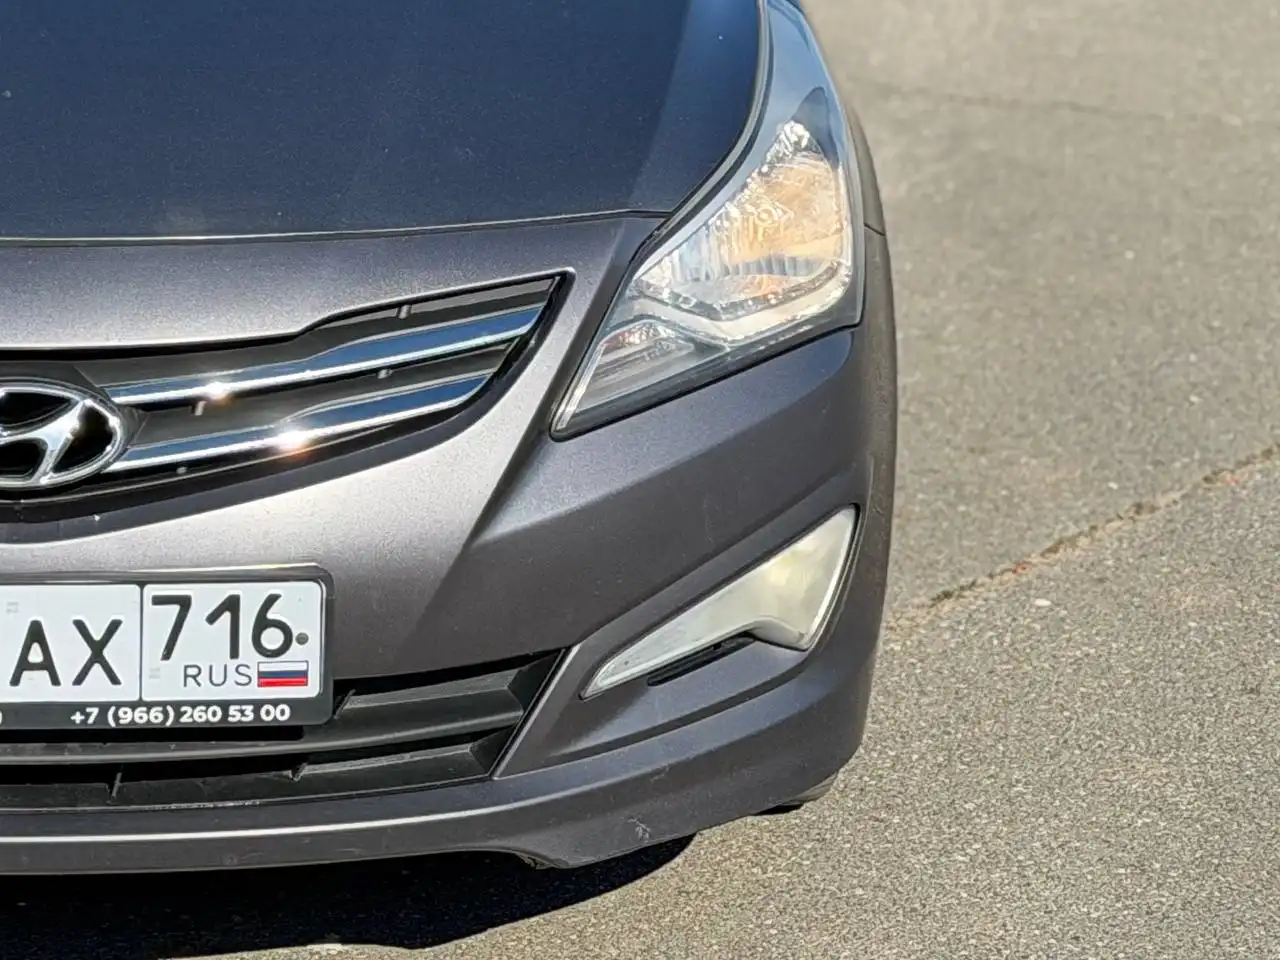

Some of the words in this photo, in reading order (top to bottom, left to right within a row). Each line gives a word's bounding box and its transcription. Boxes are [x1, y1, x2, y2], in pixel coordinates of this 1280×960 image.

[151, 593, 293, 661] 716
[183, 664, 252, 688] RUS
[70, 707, 100, 725] +7
[107, 704, 175, 728] (966)
[179, 705, 223, 724] 260
[227, 704, 255, 723] 53
[259, 703, 292, 722] 00
